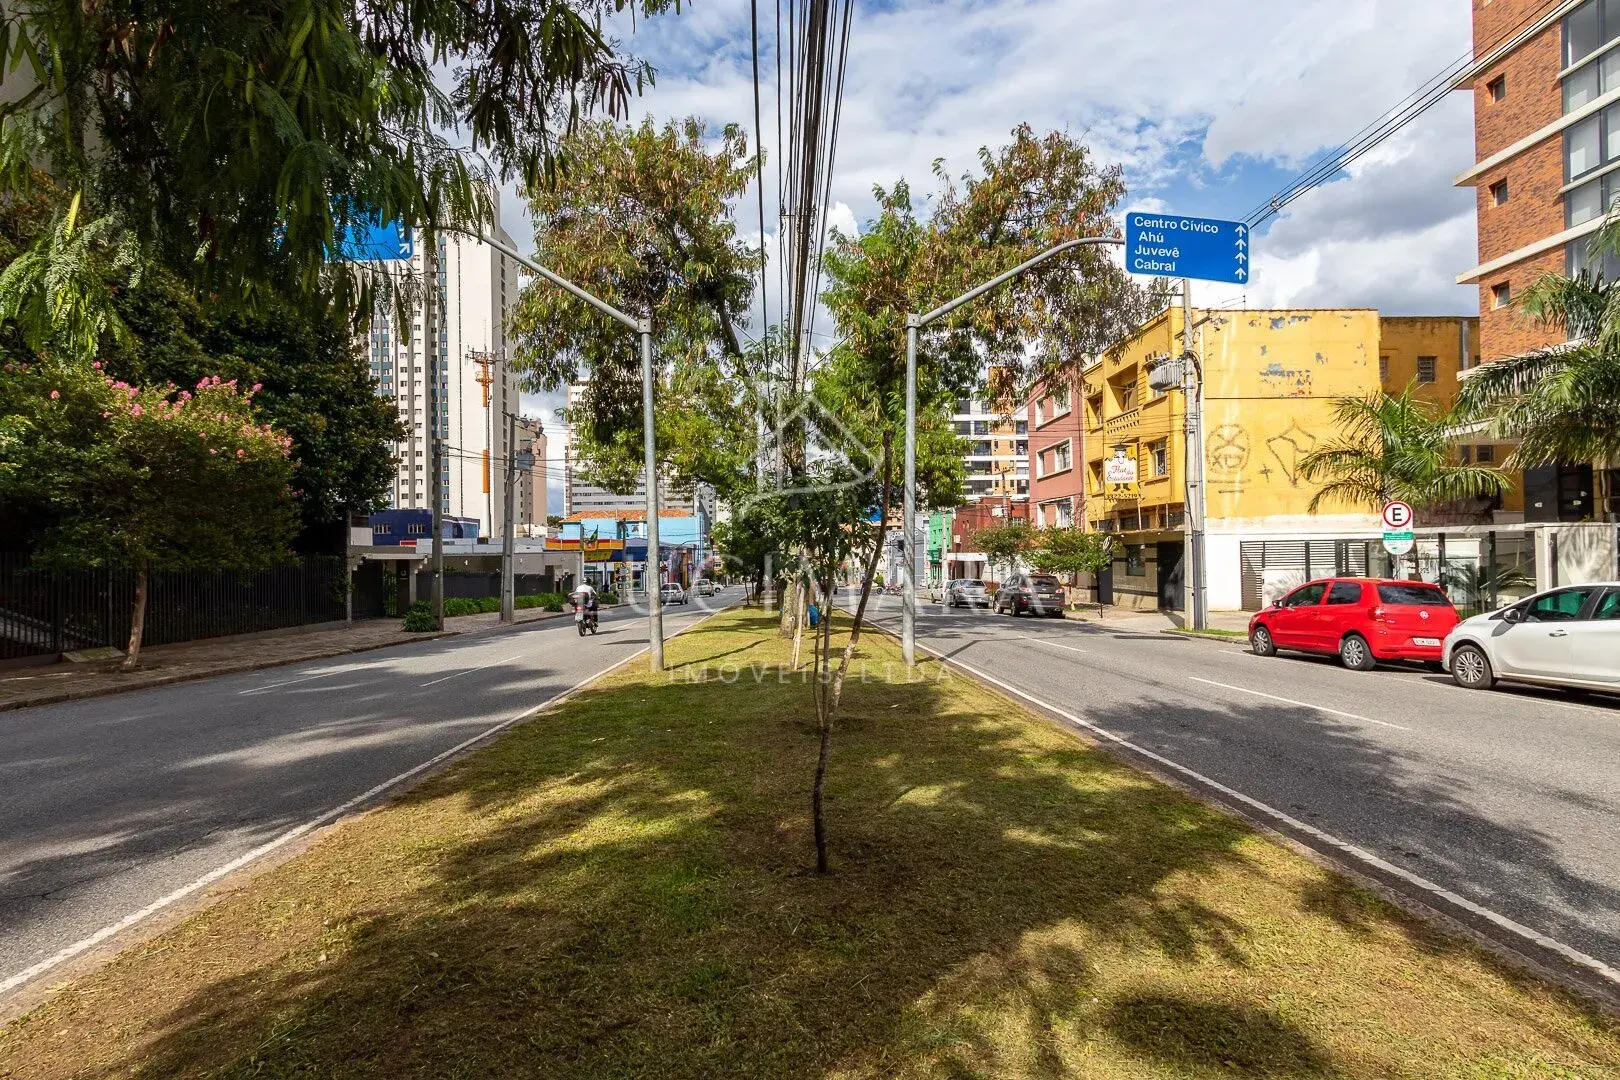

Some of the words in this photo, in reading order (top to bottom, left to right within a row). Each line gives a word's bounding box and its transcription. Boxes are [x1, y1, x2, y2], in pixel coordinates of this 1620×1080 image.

[1134, 216, 1177, 230] Centro
[1180, 219, 1219, 233] Cívico
[1138, 231, 1164, 243] Ahú
[1134, 245, 1180, 258] Juvevê
[1134, 258, 1176, 272] Cabral
[1110, 465, 1127, 474] Flat
[1391, 507, 1403, 522] E
